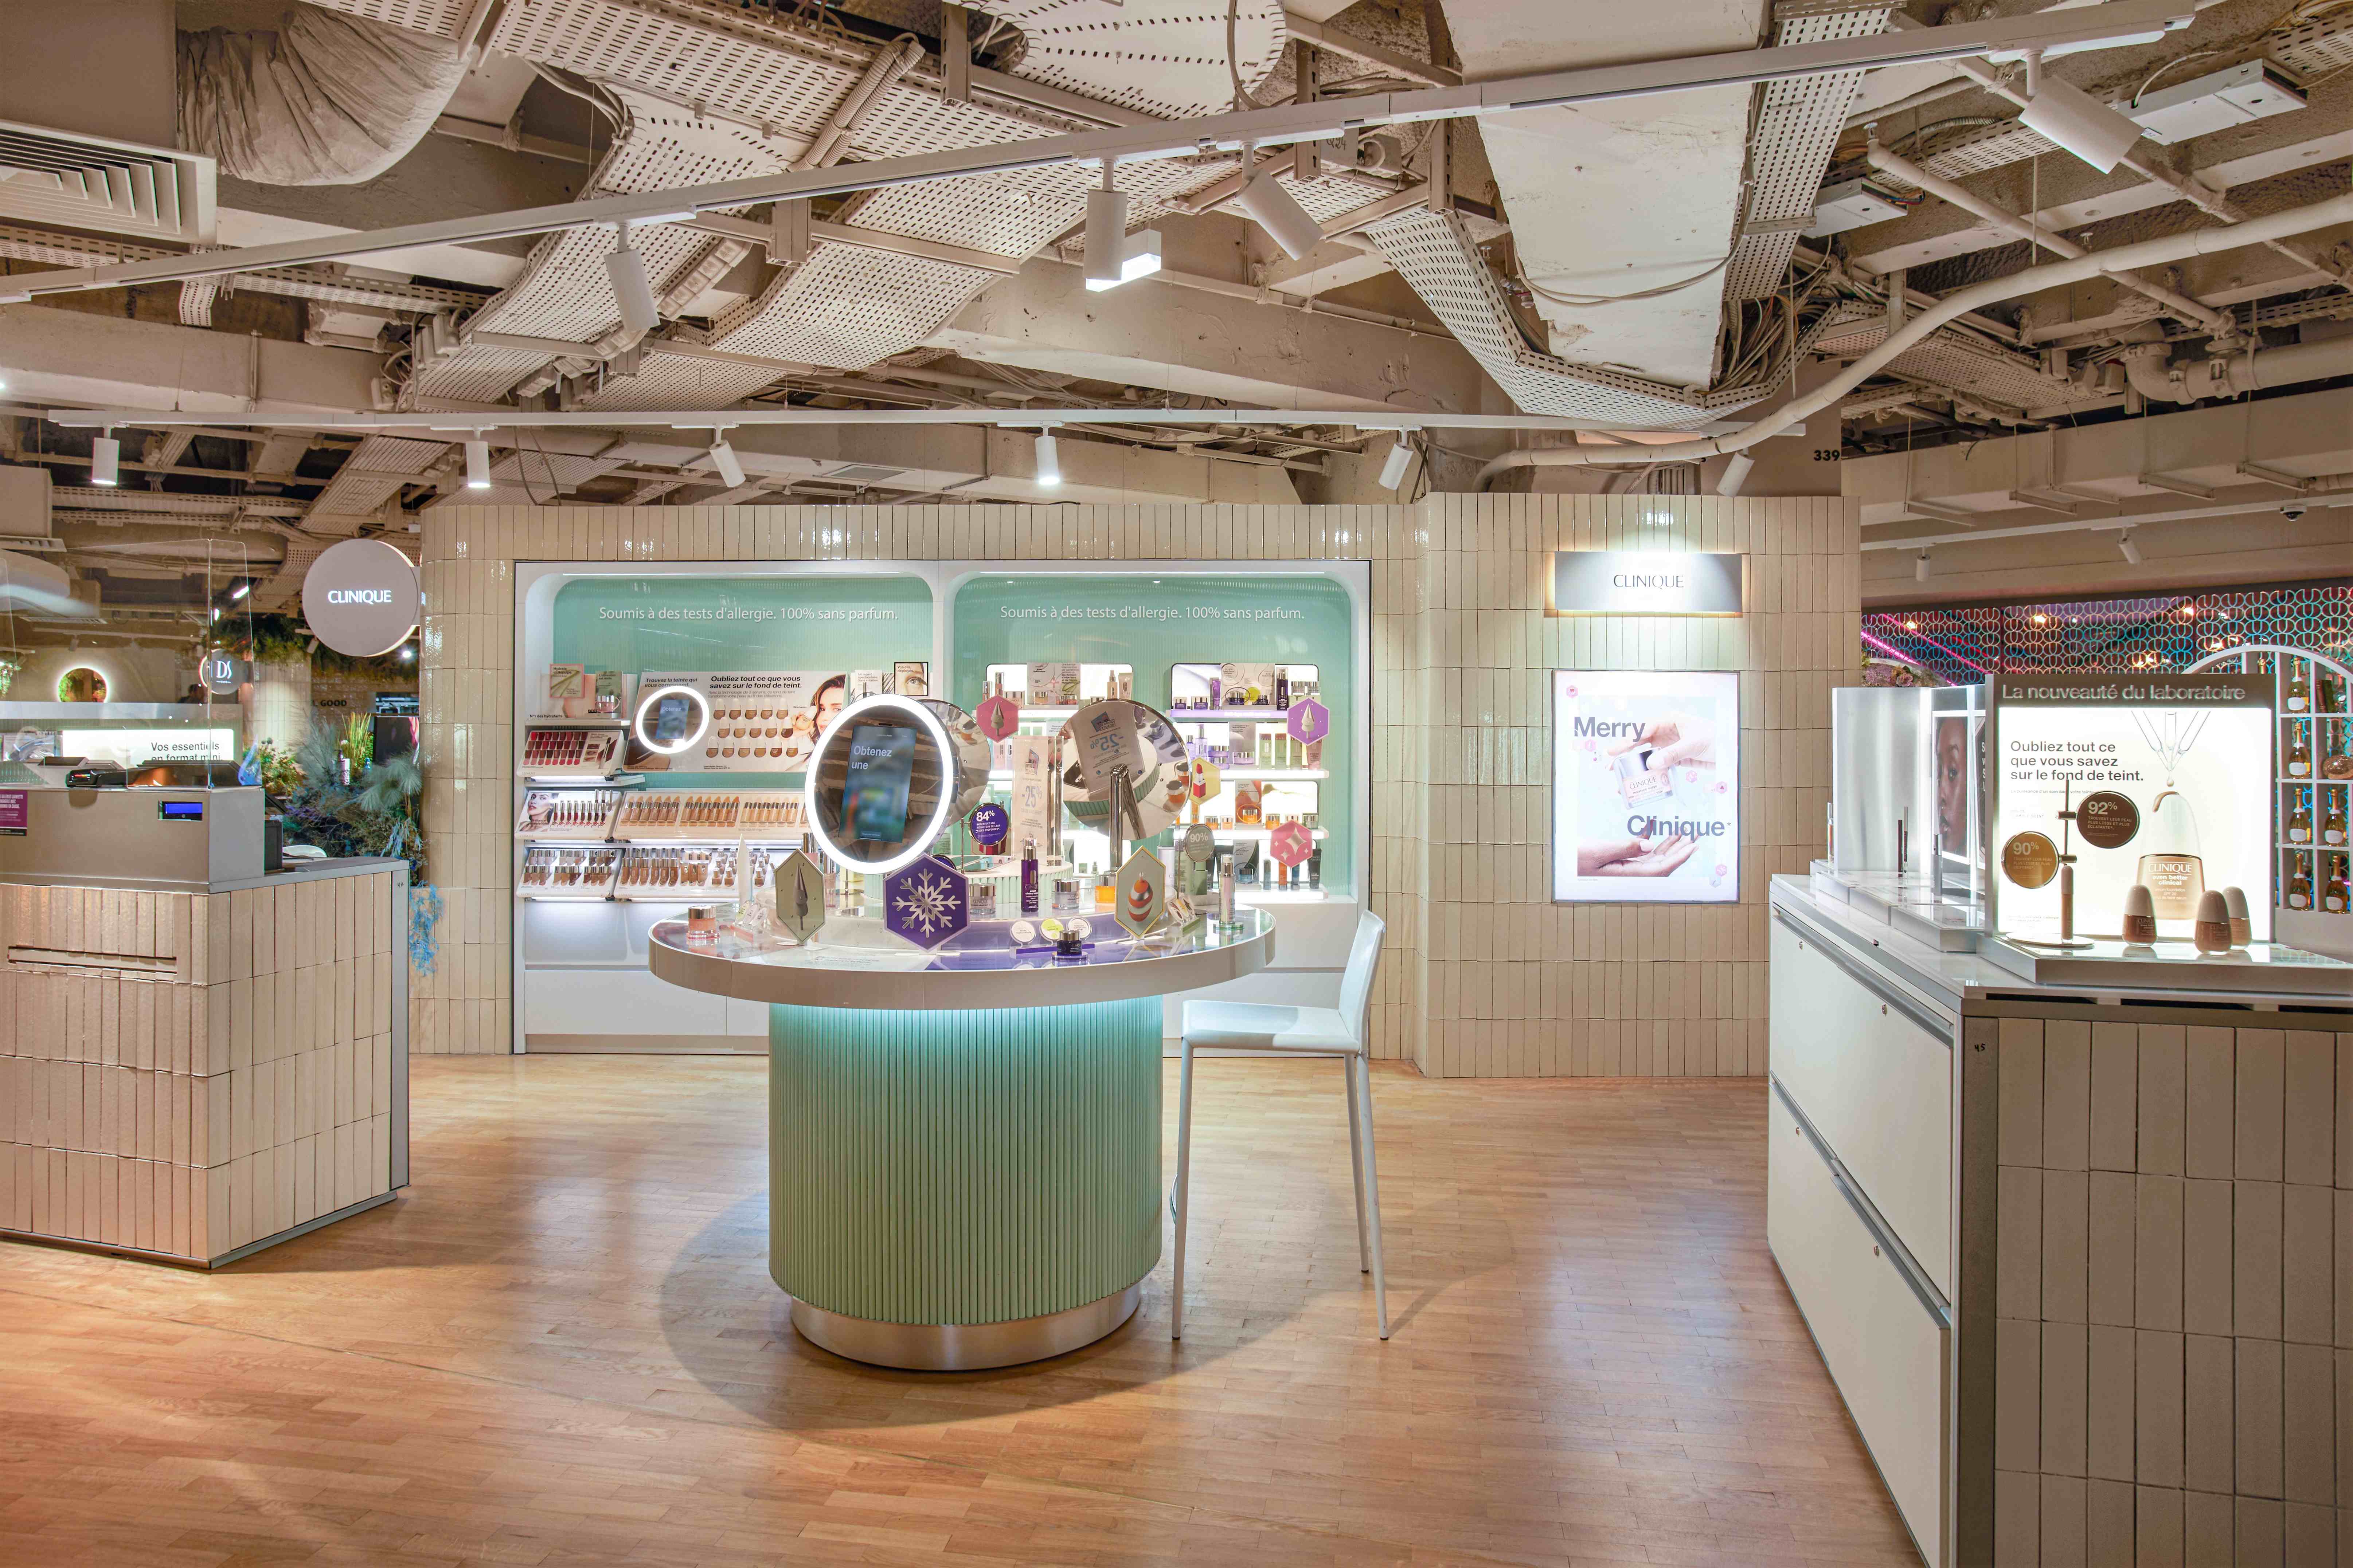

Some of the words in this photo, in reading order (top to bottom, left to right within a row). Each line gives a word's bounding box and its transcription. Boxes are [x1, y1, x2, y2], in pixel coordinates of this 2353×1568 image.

[1814, 450, 1840, 461] 339
[1614, 575, 1684, 589] CLINIQUE
[328, 589, 392, 605] CLINIQUE
[599, 607, 644, 619] Soumis
[648, 607, 655, 619] à
[658, 607, 680, 619] des
[684, 608, 712, 619] tests
[716, 607, 776, 622] d'allergie.
[781, 608, 814, 619] 100%
[818, 610, 845, 619] sans
[849, 607, 898, 622] parfum.
[1000, 606, 1047, 618] Soumis
[1050, 606, 1057, 618] à
[1061, 606, 1083, 618] des
[1087, 608, 1116, 618] tests
[1120, 606, 1182, 621] d'allergie.
[1185, 607, 1220, 618] 100%
[1224, 609, 1251, 619] sans
[1255, 607, 1305, 622] parfum.
[216, 660, 232, 679] DS
[2002, 685, 2023, 699] La
[2028, 684, 2118, 699] nouveauté
[2122, 685, 2145, 699] du
[2150, 685, 2245, 699] laboratoire
[1574, 717, 1645, 742] Merry
[151, 742, 169, 751] Vos
[853, 745, 892, 757] Obtenez
[2011, 741, 2063, 752] Oubliez
[2067, 742, 2095, 752] tout
[2099, 744, 2116, 752] ce
[851, 761, 868, 769] une
[2011, 757, 2036, 768] que
[2040, 758, 2073, 766] vous
[2077, 758, 2118, 766] savez
[2011, 772, 2033, 780] sur
[2036, 770, 2048, 780] le
[2051, 770, 2083, 780] fond
[2087, 770, 2104, 780] de
[2108, 770, 2143, 781] teint.
[1629, 776, 1656, 789] CLINIQUE
[2088, 801, 2118, 815] 92%
[976, 810, 995, 822] 84%
[1190, 832, 1208, 843] 90%
[2013, 842, 2039, 855] 90%
[2149, 863, 2192, 873] CLINIQUE
[1974, 1043, 1986, 1052] 45
